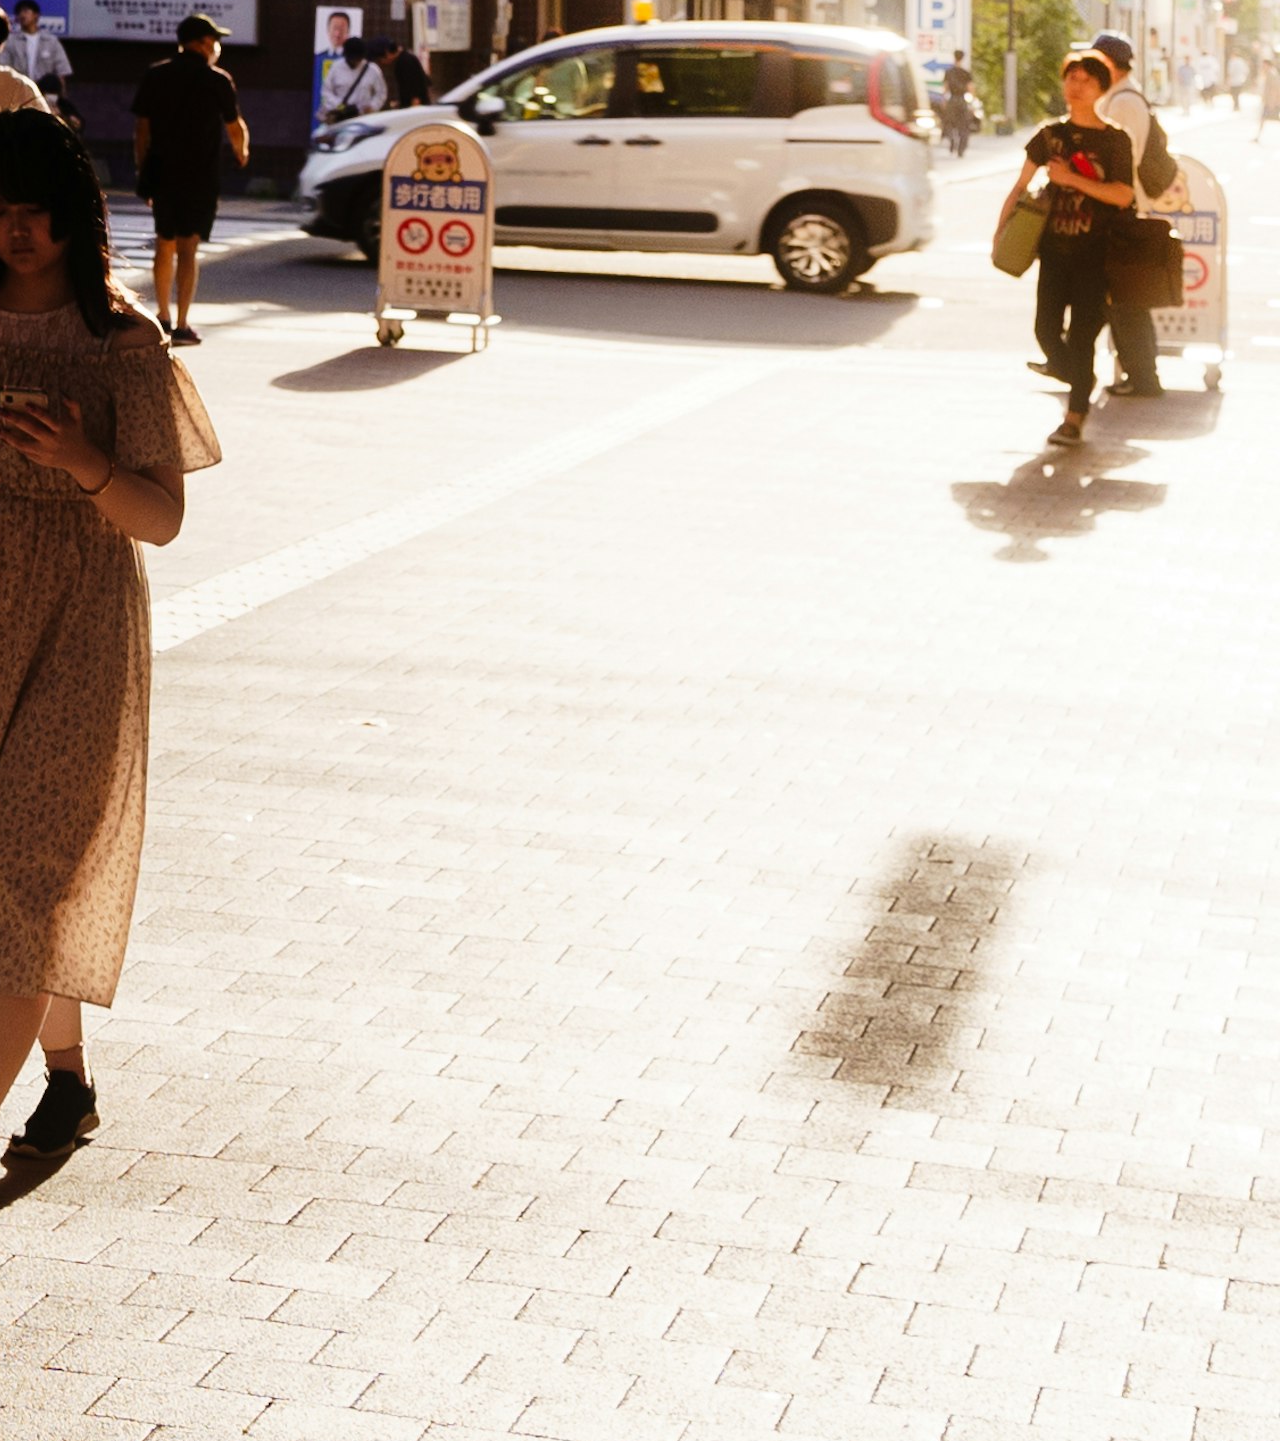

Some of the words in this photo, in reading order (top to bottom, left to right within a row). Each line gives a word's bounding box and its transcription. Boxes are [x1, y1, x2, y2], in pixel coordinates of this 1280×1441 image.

[394, 183, 482, 212] 歩行者専用
